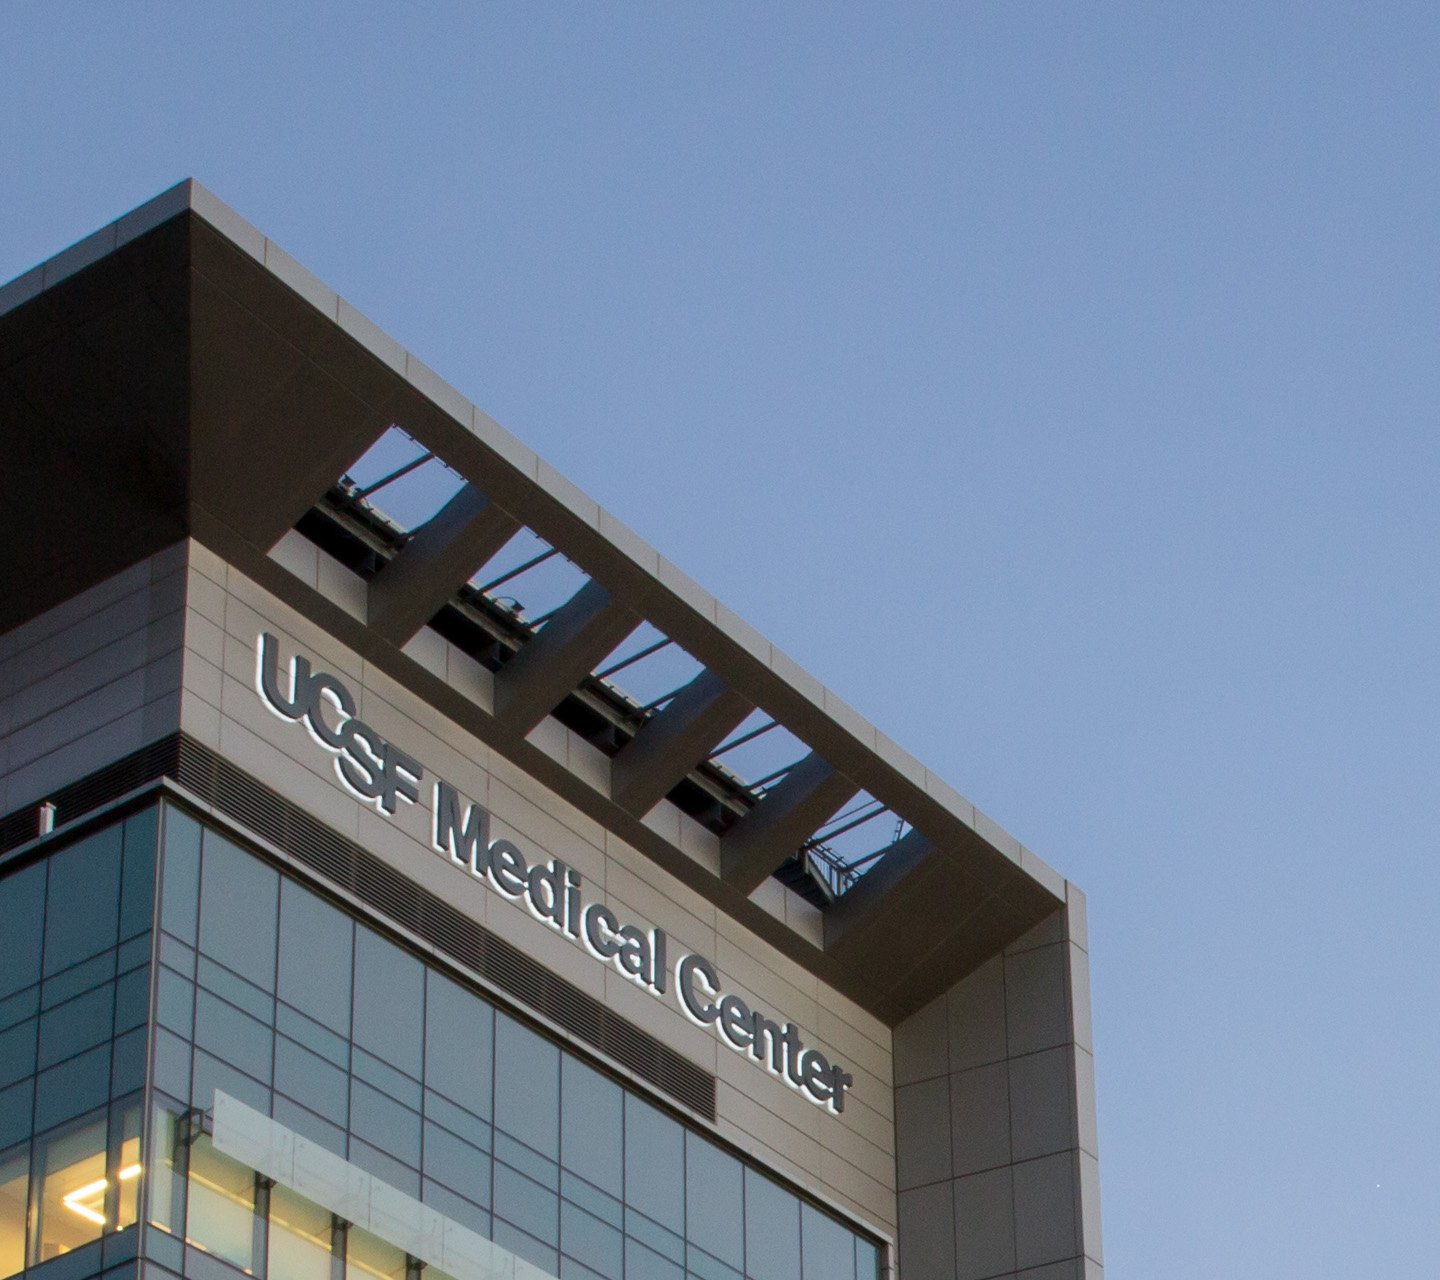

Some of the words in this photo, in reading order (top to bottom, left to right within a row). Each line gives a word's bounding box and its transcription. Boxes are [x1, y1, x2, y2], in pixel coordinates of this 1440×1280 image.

[257, 631, 423, 816] UCSF
[433, 779, 667, 996] Medical
[674, 952, 854, 1114] Center
